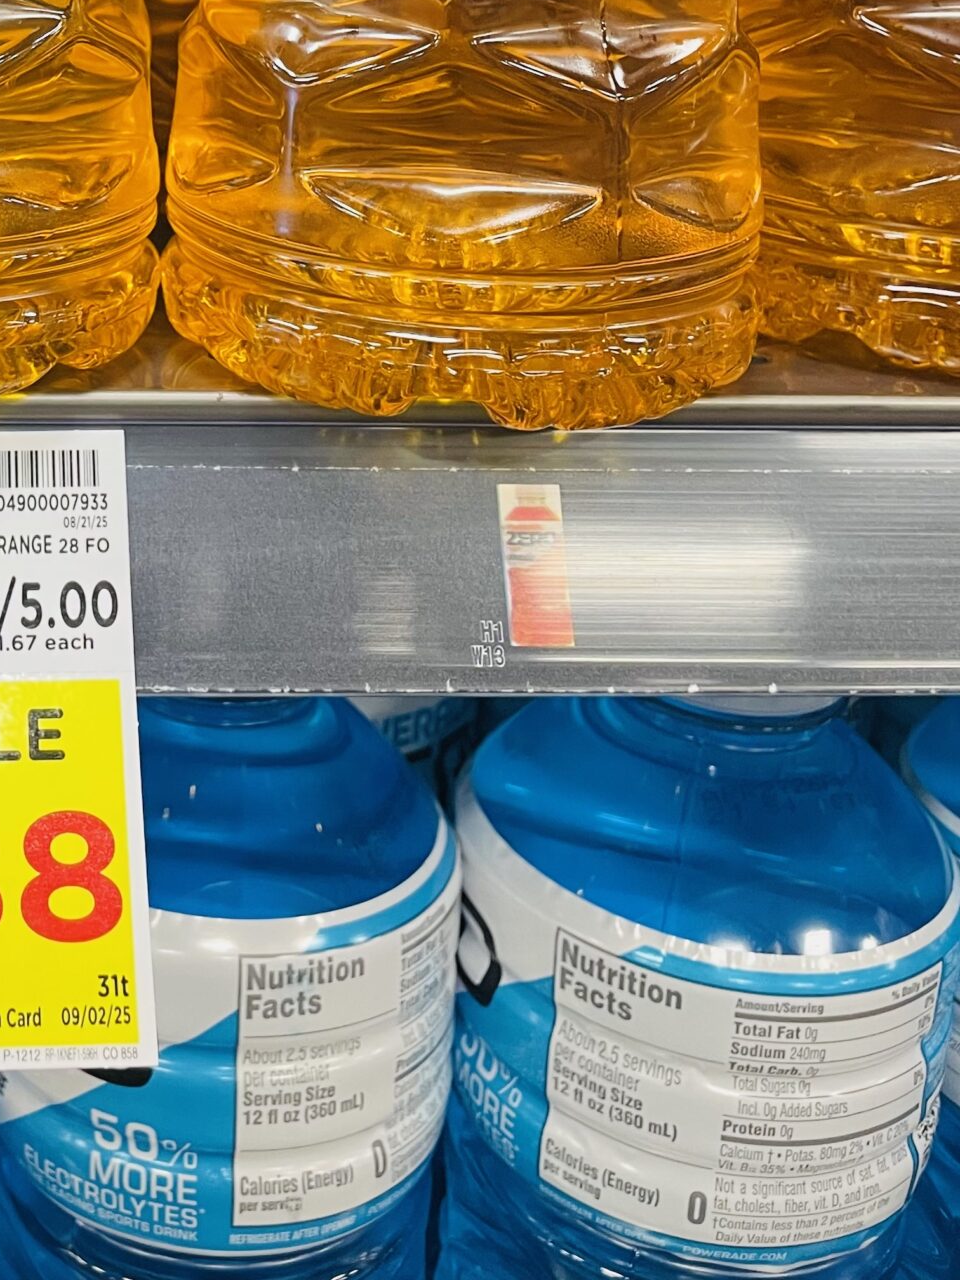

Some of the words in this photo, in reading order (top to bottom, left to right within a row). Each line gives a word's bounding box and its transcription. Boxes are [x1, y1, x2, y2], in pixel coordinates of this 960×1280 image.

[63, 516, 107, 528] 08/21/25
[59, 538, 79, 553] 28
[86, 537, 110, 553] FO
[45, 633, 94, 650] each
[246, 956, 365, 991] Nutrition
[561, 938, 682, 1010] Nutrition
[98, 974, 128, 997] 31t
[559, 966, 632, 1021] Facts
[7, 1007, 41, 1028] Card
[61, 1005, 131, 1028] 09/02/25
[246, 991, 322, 1020] Facts
[735, 999, 824, 1015] Amount/Serving
[734, 1022, 772, 1038] Total
[777, 1026, 801, 1039] Fat
[805, 1027, 818, 1042] 0g
[3, 1049, 40, 1062] P-1212
[103, 1047, 119, 1060] CO
[120, 1047, 137, 1059] 858
[730, 1042, 785, 1059] Sodium
[790, 1047, 826, 1061] 240mg
[91, 1108, 198, 1170] 50%
[722, 1120, 776, 1137] Protein
[780, 1126, 794, 1140] 0g
[24, 1143, 198, 1228] ELECTROLYTES
[90, 1150, 197, 1206] MORE
[687, 1191, 707, 1224] 0
